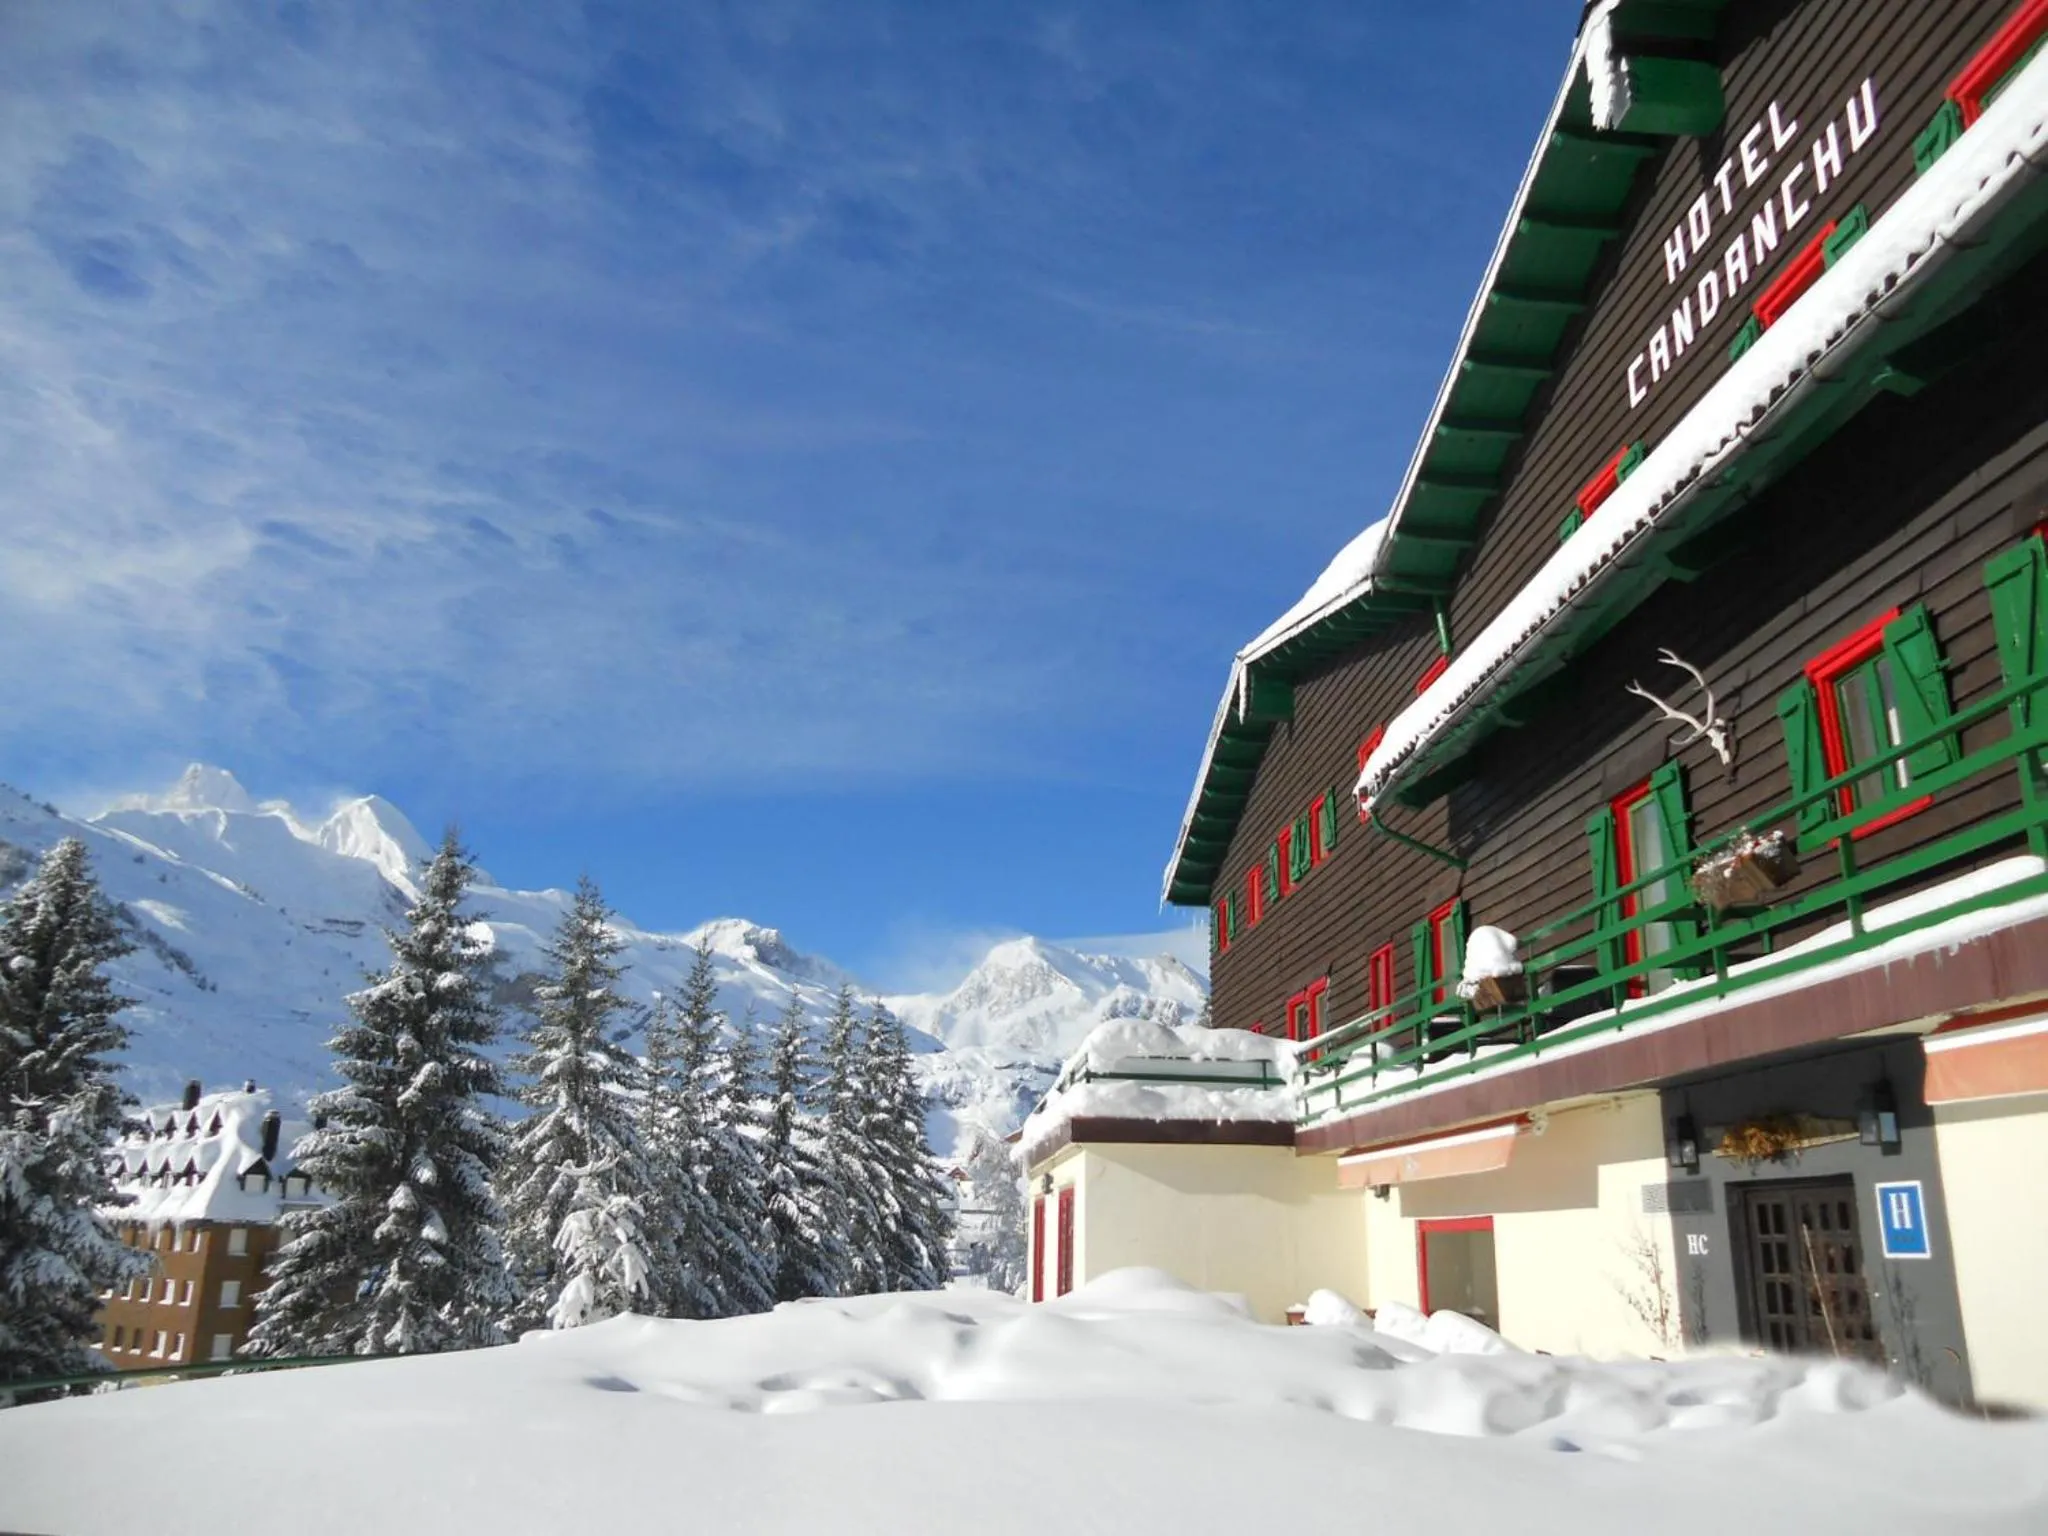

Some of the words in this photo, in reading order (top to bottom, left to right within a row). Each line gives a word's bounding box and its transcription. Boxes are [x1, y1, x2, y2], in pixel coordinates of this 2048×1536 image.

[1627, 77, 1878, 409] CANDANCHU
[1664, 100, 1798, 285] HOTEL
[1686, 1234, 1709, 1255] HC
[1888, 1192, 1913, 1230] H
